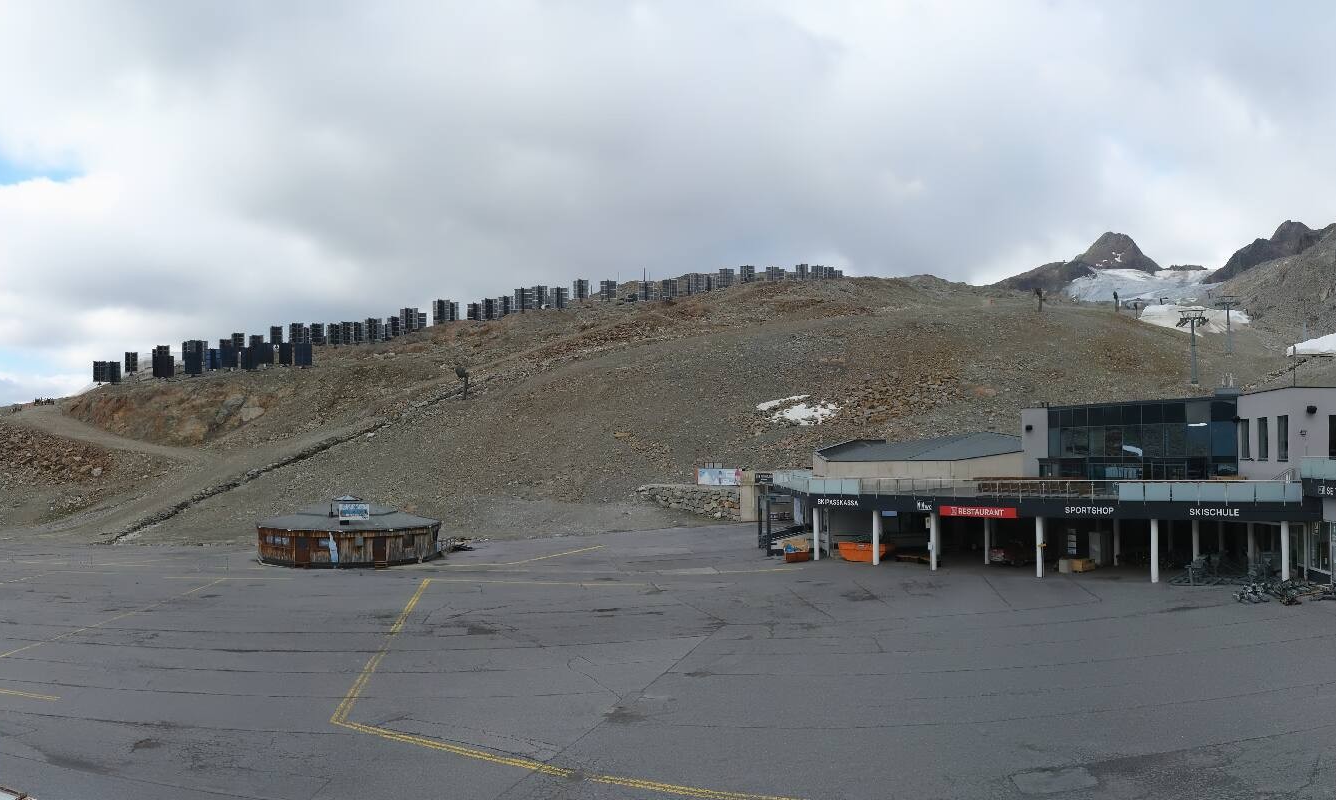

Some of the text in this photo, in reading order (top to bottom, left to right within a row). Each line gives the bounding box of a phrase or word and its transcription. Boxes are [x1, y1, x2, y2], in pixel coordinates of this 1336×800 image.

[958, 507, 1004, 517] RESTAURANT
[1064, 506, 1115, 515] SPORTSHOP
[1189, 508, 1240, 517] SKISCHULE
